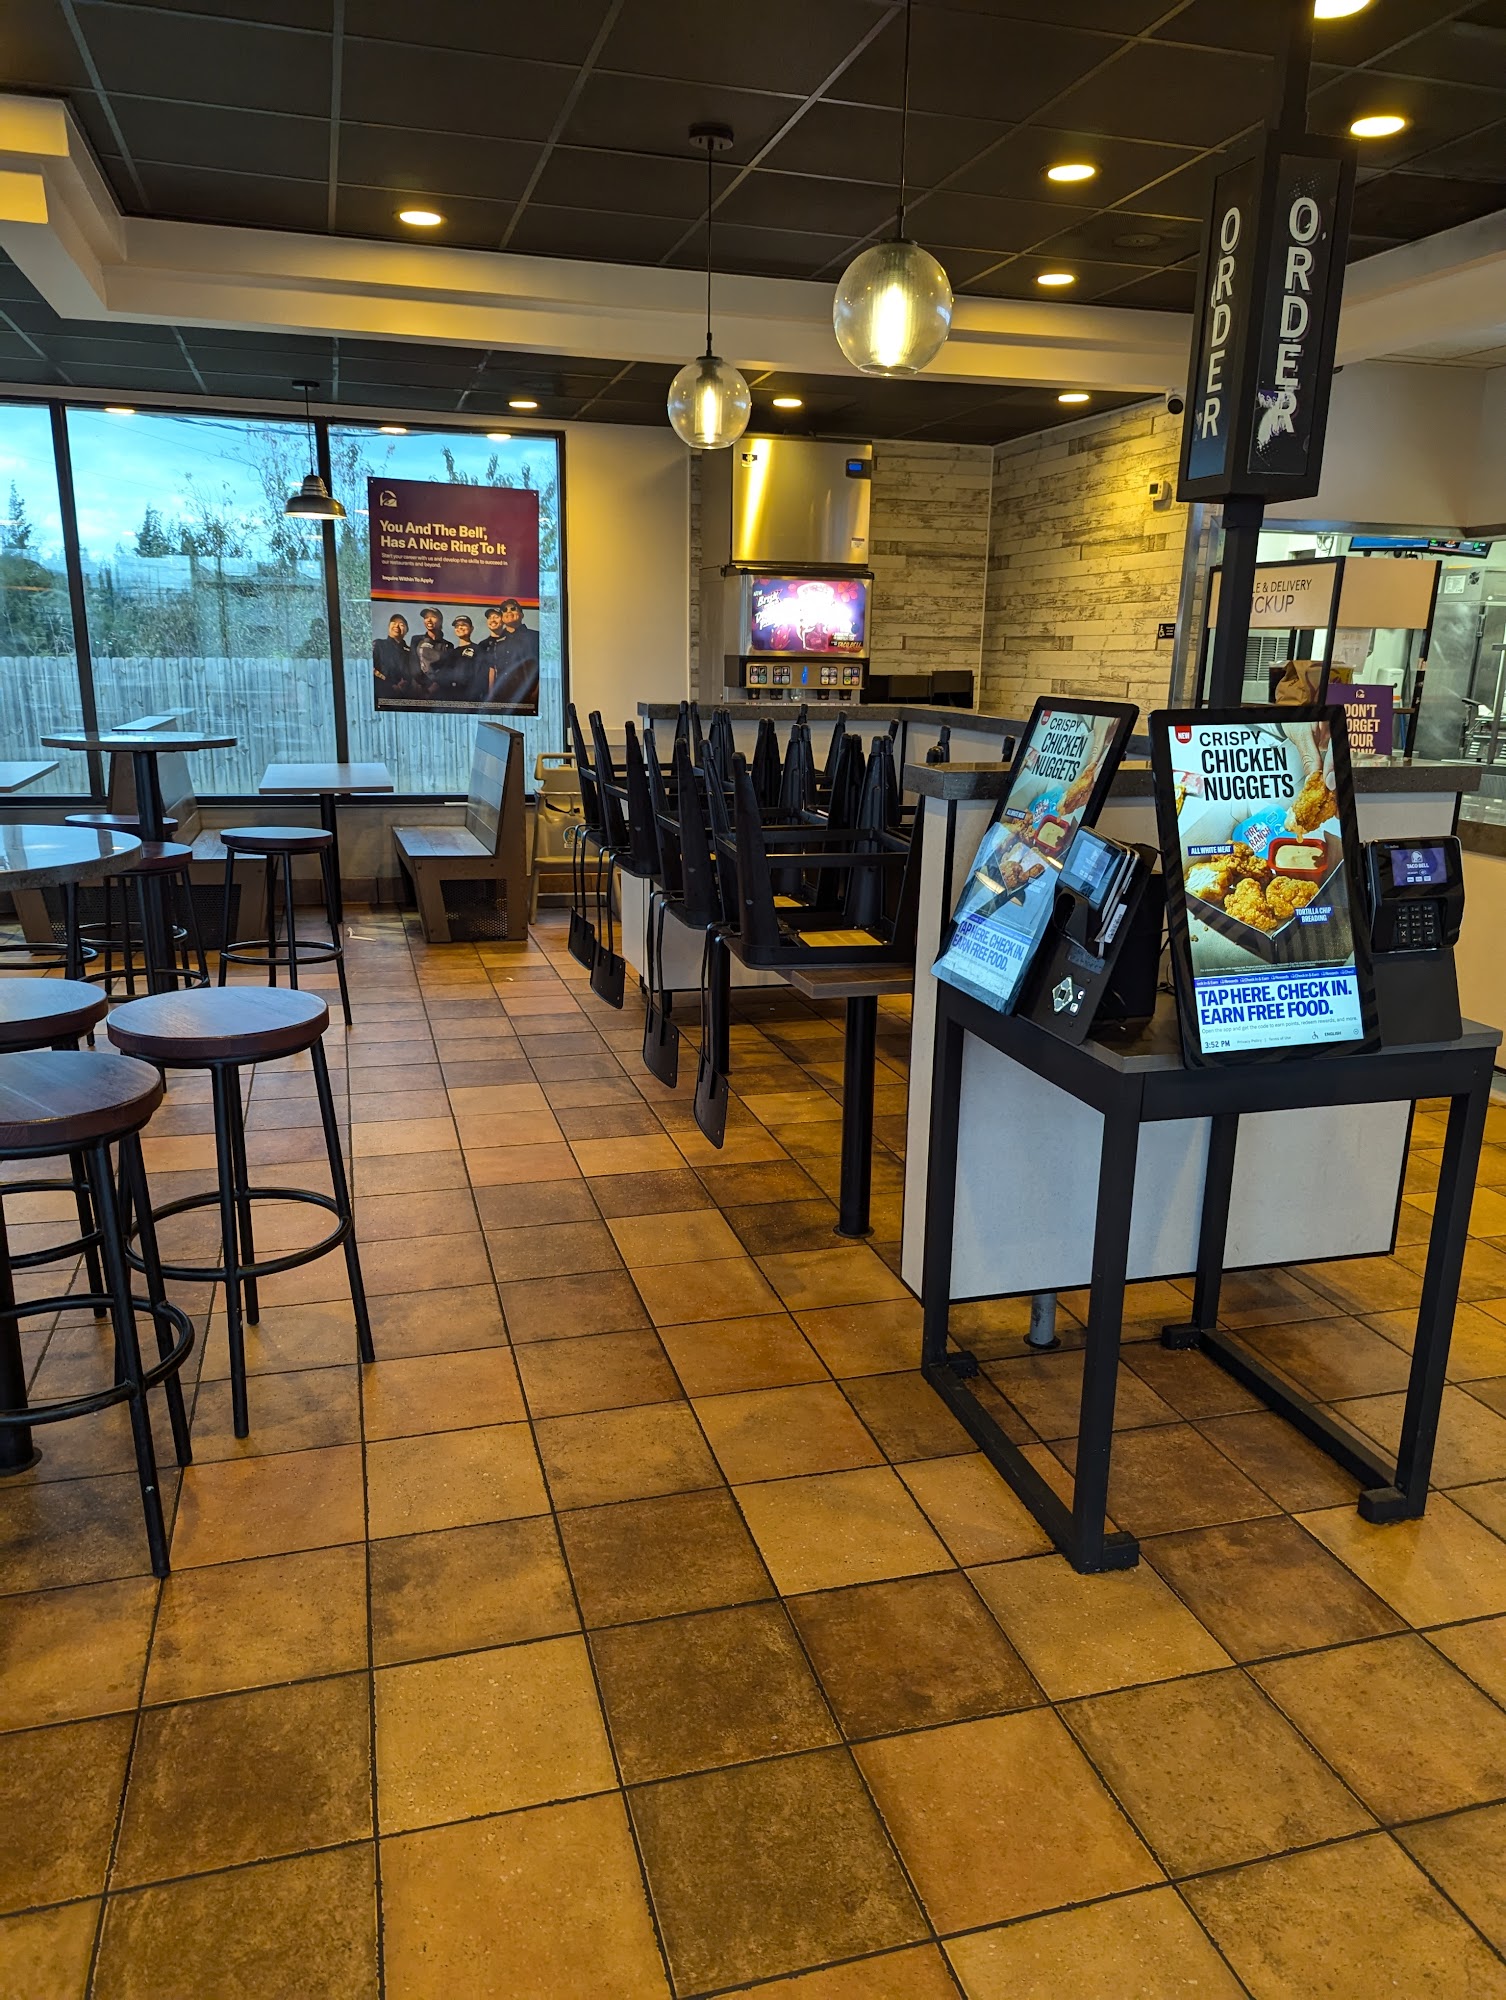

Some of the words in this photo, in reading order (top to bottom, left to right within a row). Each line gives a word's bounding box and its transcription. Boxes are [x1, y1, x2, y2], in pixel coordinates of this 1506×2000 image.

[1201, 206, 1241, 439] ORDER
[1274, 197, 1321, 433] ORDER
[380, 519, 403, 533] You
[405, 521, 431, 535] And
[432, 523, 457, 537] The
[380, 535, 406, 549] Has
[407, 537, 418, 549] A
[420, 537, 448, 551] Nice
[451, 540, 479, 556] Ring
[479, 542, 495, 554] To
[496, 542, 506, 555] It
[1262, 582, 1268, 593] &
[1270, 579, 1312, 592] DELIVERY
[1250, 594, 1295, 614] ICKUP
[1344, 703, 1377, 718] DON'T
[1050, 717, 1083, 732] CRISPY
[1345, 718, 1380, 732] ORGET
[1041, 732, 1088, 758] CHICKEN
[1177, 732, 1190, 740] NEW
[1199, 730, 1261, 747] CRISPY
[1031, 755, 1081, 782] NUGGETS
[1201, 747, 1288, 774] CHICKEN
[1203, 773, 1295, 801] NUGGETS
[1243, 822, 1260, 840] FIRE
[1248, 825, 1273, 851] RANCH
[1191, 847, 1201, 855] ALL
[1201, 846, 1217, 854] WHITE
[1218, 845, 1231, 853] MEAT
[1295, 907, 1319, 916] TORTILLA
[1319, 906, 1332, 914] CHIP
[1301, 914, 1328, 923] BREADING
[957, 920, 973, 936] TAP
[988, 933, 1016, 957] CHECK
[1014, 945, 1025, 962] IN.
[951, 934, 973, 954] EARN
[970, 942, 989, 962] FREE
[986, 949, 1009, 972] FOOD.
[1198, 989, 1229, 1007] TAP
[1230, 986, 1275, 1004] HERE.
[1277, 981, 1331, 1001] CHECK
[1331, 980, 1352, 996] IN.
[1201, 1006, 1245, 1025] EARN
[1247, 1003, 1285, 1021] FREE
[1287, 999, 1334, 1018] FOOD.
[1205, 1041, 1219, 1049] 3:52
